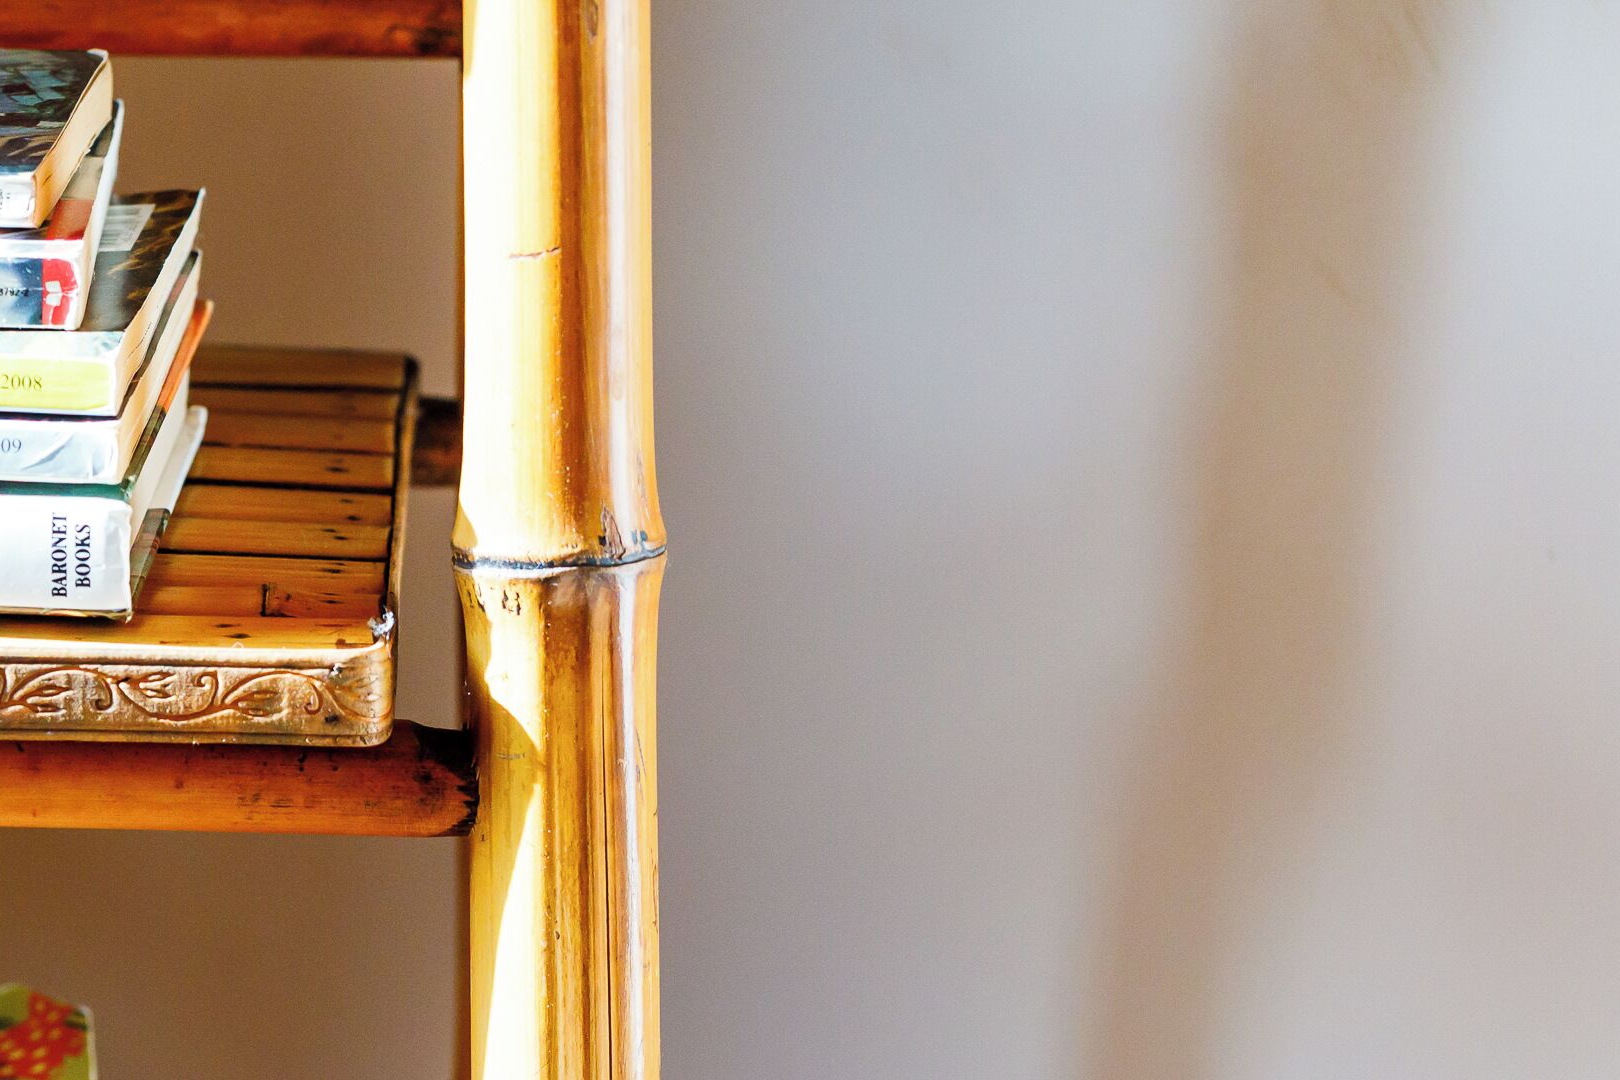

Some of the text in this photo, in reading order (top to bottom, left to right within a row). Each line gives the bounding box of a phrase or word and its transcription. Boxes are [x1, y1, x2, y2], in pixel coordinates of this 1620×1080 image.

[0, 372, 43, 391] 2008
[51, 511, 68, 598] BARONET
[74, 524, 92, 589] BOOKS
